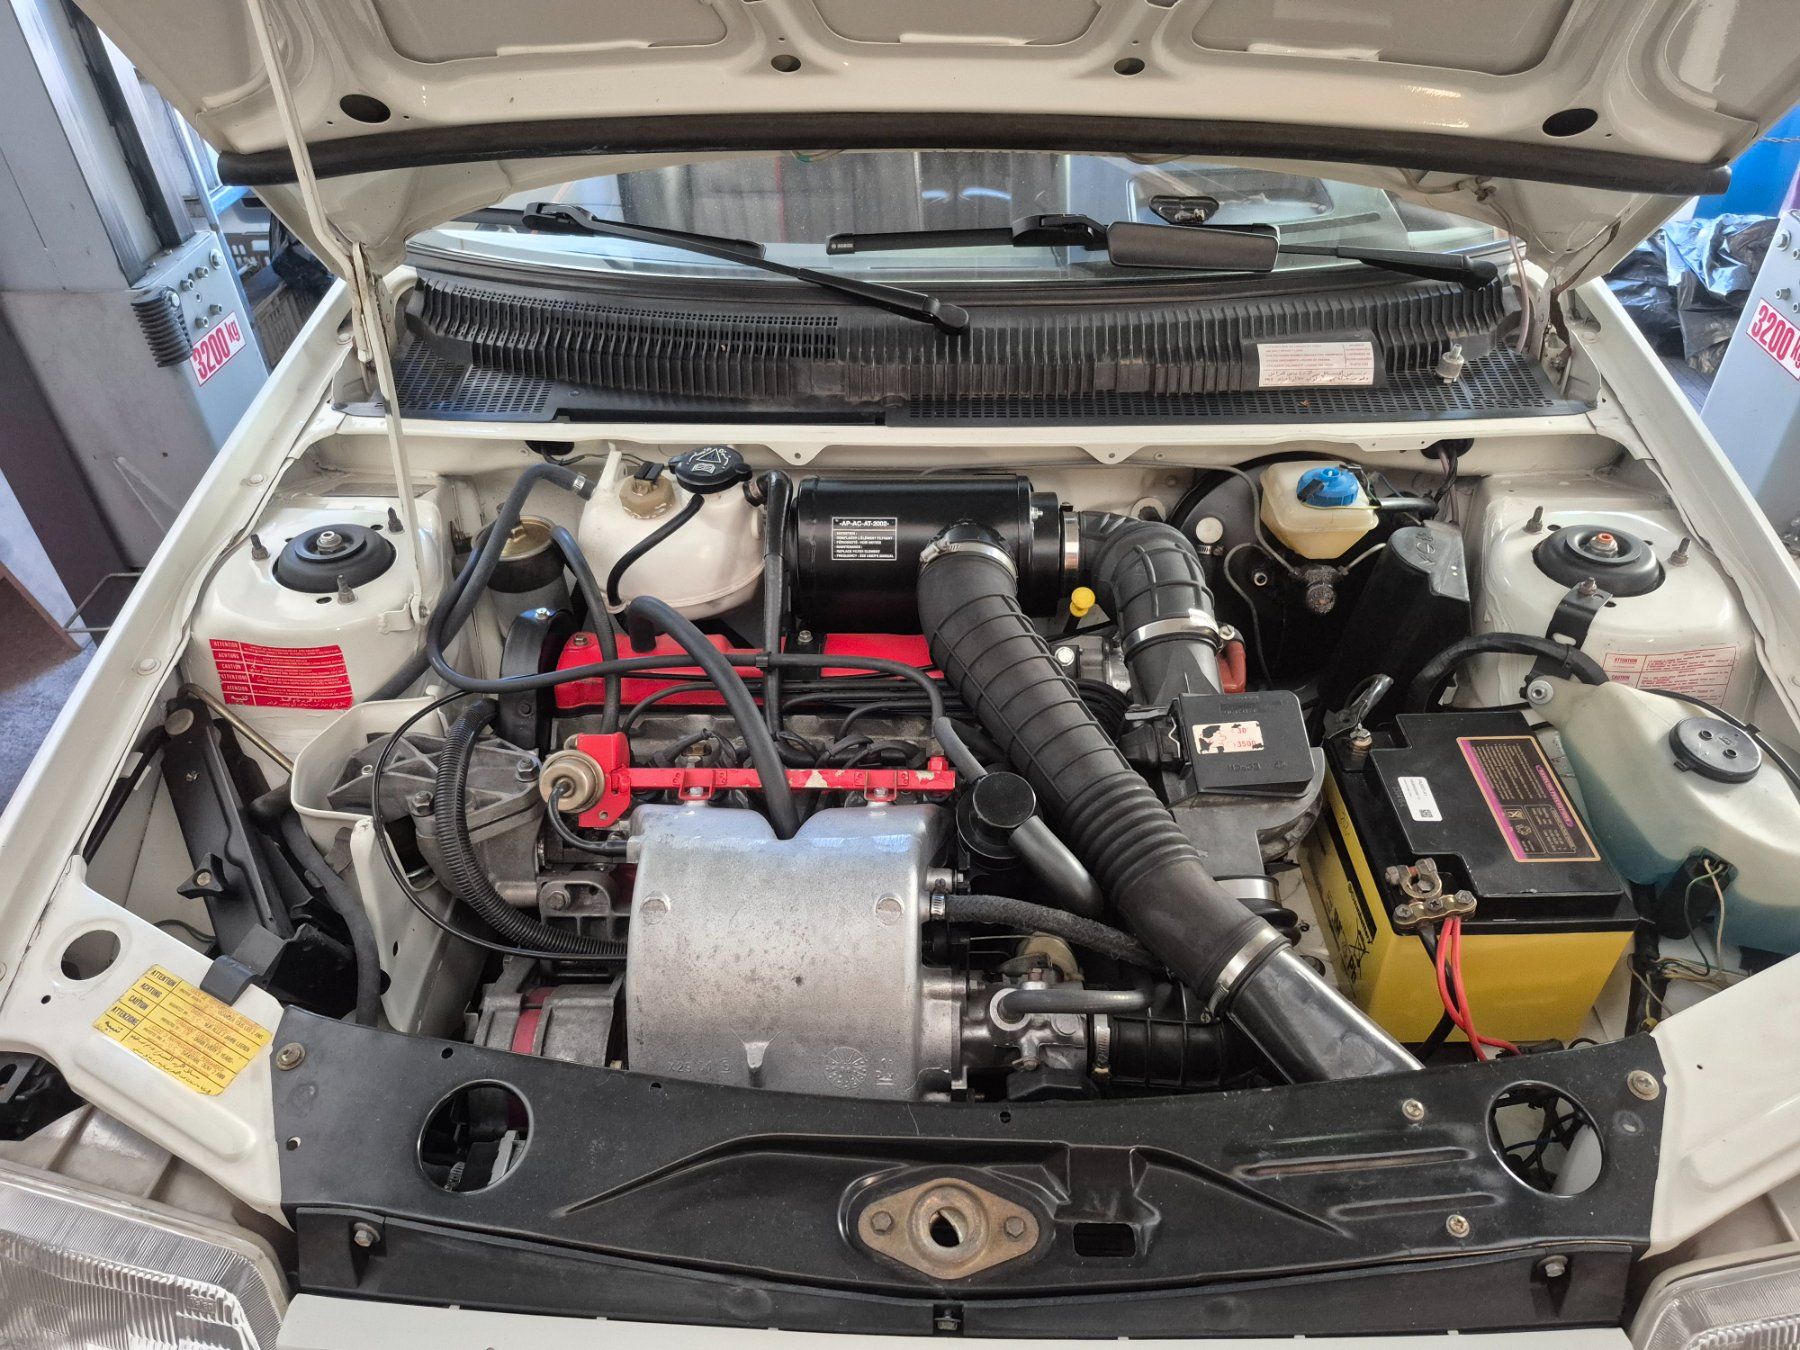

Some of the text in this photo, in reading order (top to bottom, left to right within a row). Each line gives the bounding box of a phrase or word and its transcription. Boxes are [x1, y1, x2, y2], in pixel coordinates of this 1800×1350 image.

[192, 320, 241, 380] 3200 kg
[1751, 305, 1795, 361] 3200
[151, 969, 177, 988] ATTENTION
[128, 995, 149, 1010] CAUTION
